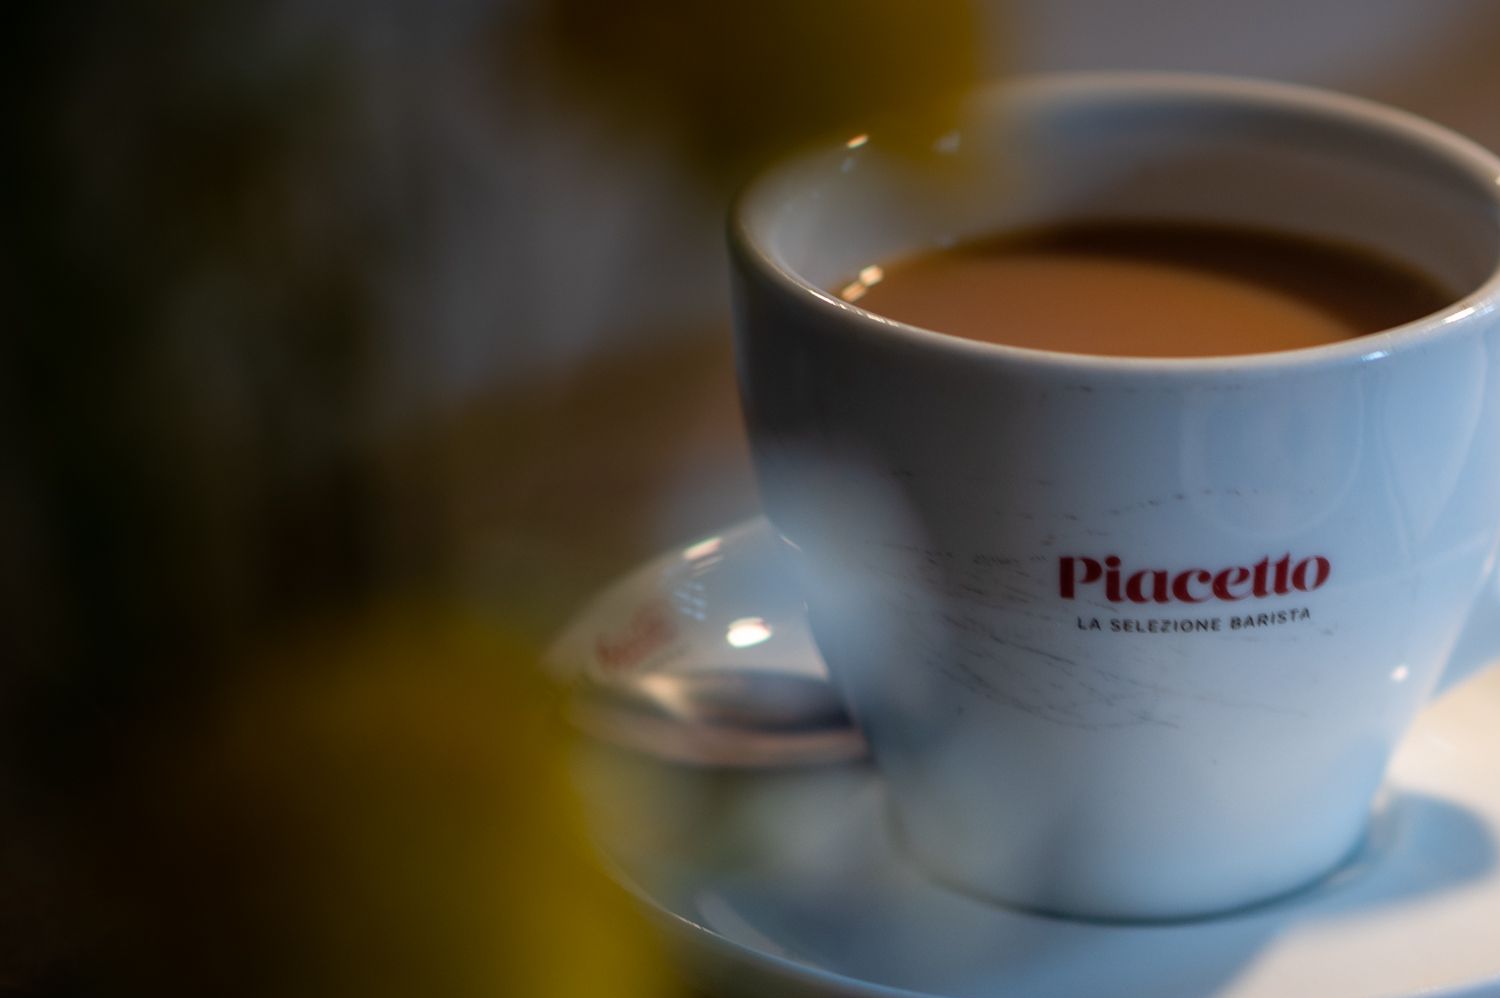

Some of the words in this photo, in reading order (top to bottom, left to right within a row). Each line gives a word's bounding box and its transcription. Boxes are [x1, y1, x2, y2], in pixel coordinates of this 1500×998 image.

[1058, 552, 1331, 604] Piacetto
[1077, 617, 1102, 631] LA
[1110, 618, 1222, 633] SELEZIONE
[1230, 606, 1311, 631] BARISTA
